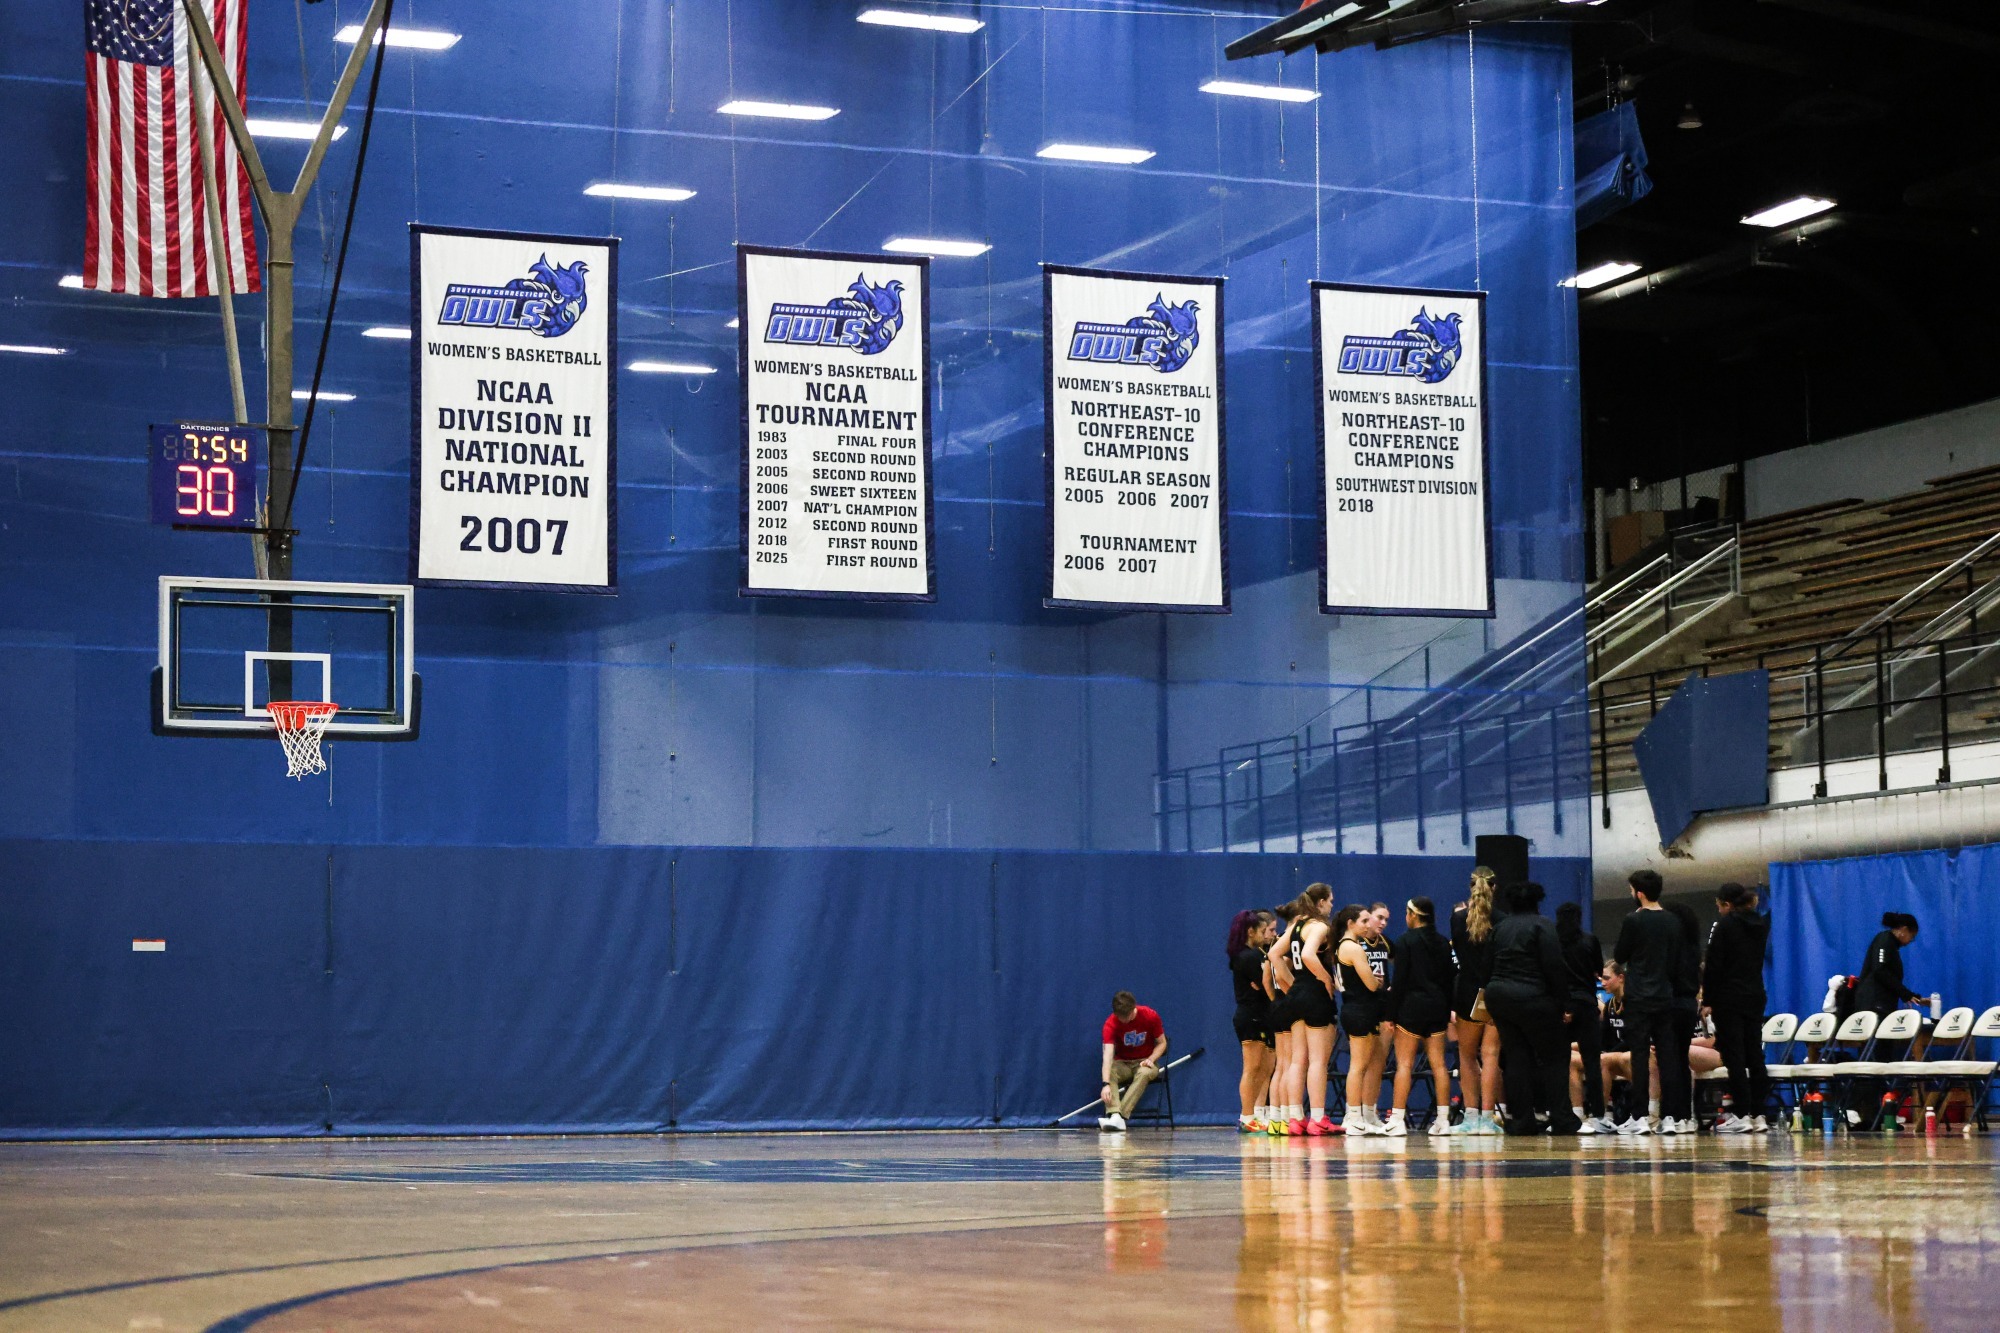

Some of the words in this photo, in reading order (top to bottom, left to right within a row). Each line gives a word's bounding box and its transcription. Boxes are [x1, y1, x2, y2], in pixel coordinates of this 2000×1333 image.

[440, 294, 547, 328] OWLS
[766, 314, 865, 346] OWLS
[428, 343, 500, 359] WOMEN'S
[506, 348, 601, 365] BASKETBALL
[1069, 332, 1163, 364] OWLS
[1338, 345, 1428, 375] OWLS
[755, 360, 822, 375] WOMEN'S
[828, 365, 917, 381] BASKETBALL
[478, 380, 553, 404] NCAA
[806, 382, 867, 404] NCAA
[1058, 377, 1122, 393] WOMEN'S
[1128, 383, 1210, 398] BASKETBALL
[1329, 390, 1389, 404] WOMEN'S
[1396, 393, 1476, 407] BASKETBALL
[756, 404, 916, 430] TOURNAMENT
[1072, 401, 1200, 422] NORTHEAST-10
[180, 424, 230, 432] DAKTRONICS
[439, 408, 562, 435] DIVISION
[574, 415, 591, 437] II
[1079, 422, 1194, 442] CONFERENCE
[1342, 413, 1464, 431] NORTHEAST-10
[184, 434, 247, 463] 7:54
[758, 431, 786, 442] 1983
[838, 436, 876, 447] FINAL
[882, 438, 916, 449] FOUR
[1349, 433, 1458, 450] CONFERENCE
[446, 439, 584, 467] NATIONAL
[757, 449, 787, 459] 2003
[813, 451, 865, 463] SECOND
[871, 454, 915, 465] ROUND
[1084, 442, 1188, 461] CHAMPIONS
[1355, 452, 1453, 469] CHAMPIONS
[441, 470, 589, 498] CHAMPION
[757, 466, 787, 477] 2005
[813, 469, 865, 480] SECOND
[871, 471, 916, 483] ROUND
[1065, 467, 1141, 484] REGULAR
[1147, 472, 1210, 488] SEASON
[177, 465, 234, 516] 30
[757, 483, 787, 494] 2006
[811, 486, 855, 497] SWEET
[861, 488, 916, 500] SIXTEEN
[1336, 478, 1415, 492] SOUTHWEST
[1419, 481, 1477, 495] DIVISION
[1066, 488, 1103, 503] 2005
[1118, 491, 1156, 506] 2006
[1171, 494, 1208, 508] 2007
[1339, 499, 1373, 512] 2018
[758, 500, 787, 511] 2007
[804, 502, 841, 514] NAT'L
[846, 504, 917, 517] CHAMPION
[759, 517, 786, 528] 2012
[813, 520, 865, 532] SECOND
[871, 522, 917, 533] ROUND
[460, 516, 568, 555] 2007
[758, 535, 786, 545] 2018
[829, 538, 866, 549] FIRST
[872, 539, 917, 550] ROUND
[1081, 535, 1196, 553] TOURNAMENT
[757, 552, 787, 563] 2025
[827, 555, 865, 566] FIRST
[871, 557, 917, 568] ROUND
[1065, 555, 1104, 570] 2006
[1119, 558, 1156, 573] 2007
[1291, 940, 1302, 970] 8
[1370, 961, 1385, 976] 21
